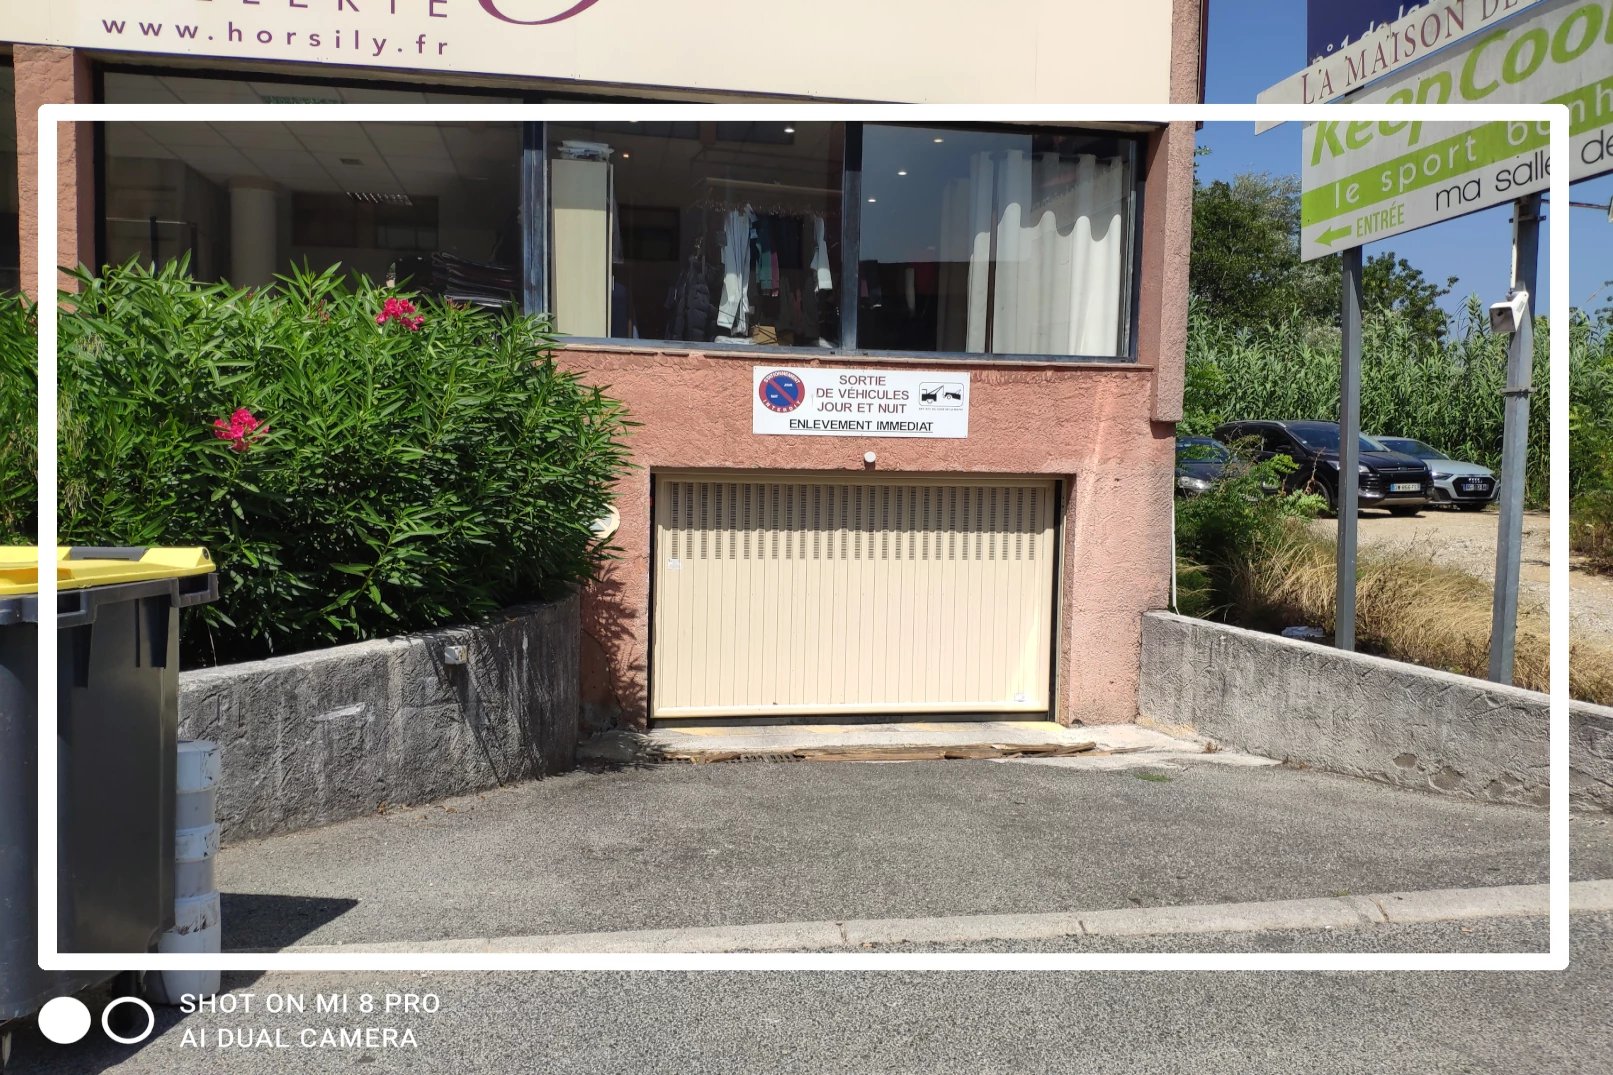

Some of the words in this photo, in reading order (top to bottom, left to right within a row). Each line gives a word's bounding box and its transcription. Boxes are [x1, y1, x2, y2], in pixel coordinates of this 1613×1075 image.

[101, 18, 448, 57] www.horsily.fr
[1301, 68, 1334, 104] LA
[1345, 0, 1465, 86] MAISON
[1334, 181, 1360, 209] le
[1381, 135, 1477, 193] sport
[1436, 177, 1481, 211] ma
[1356, 201, 1405, 239] ENTRÉE
[816, 388, 834, 399] DE
[838, 387, 910, 401] VÉHICULES
[839, 375, 886, 386] SORTIE
[789, 418, 872, 430] ENLEVEMENT
[876, 421, 934, 432] IMMEDIAT
[817, 402, 853, 412] JOUR
[857, 402, 874, 413] ET
[878, 403, 907, 414] NUIT
